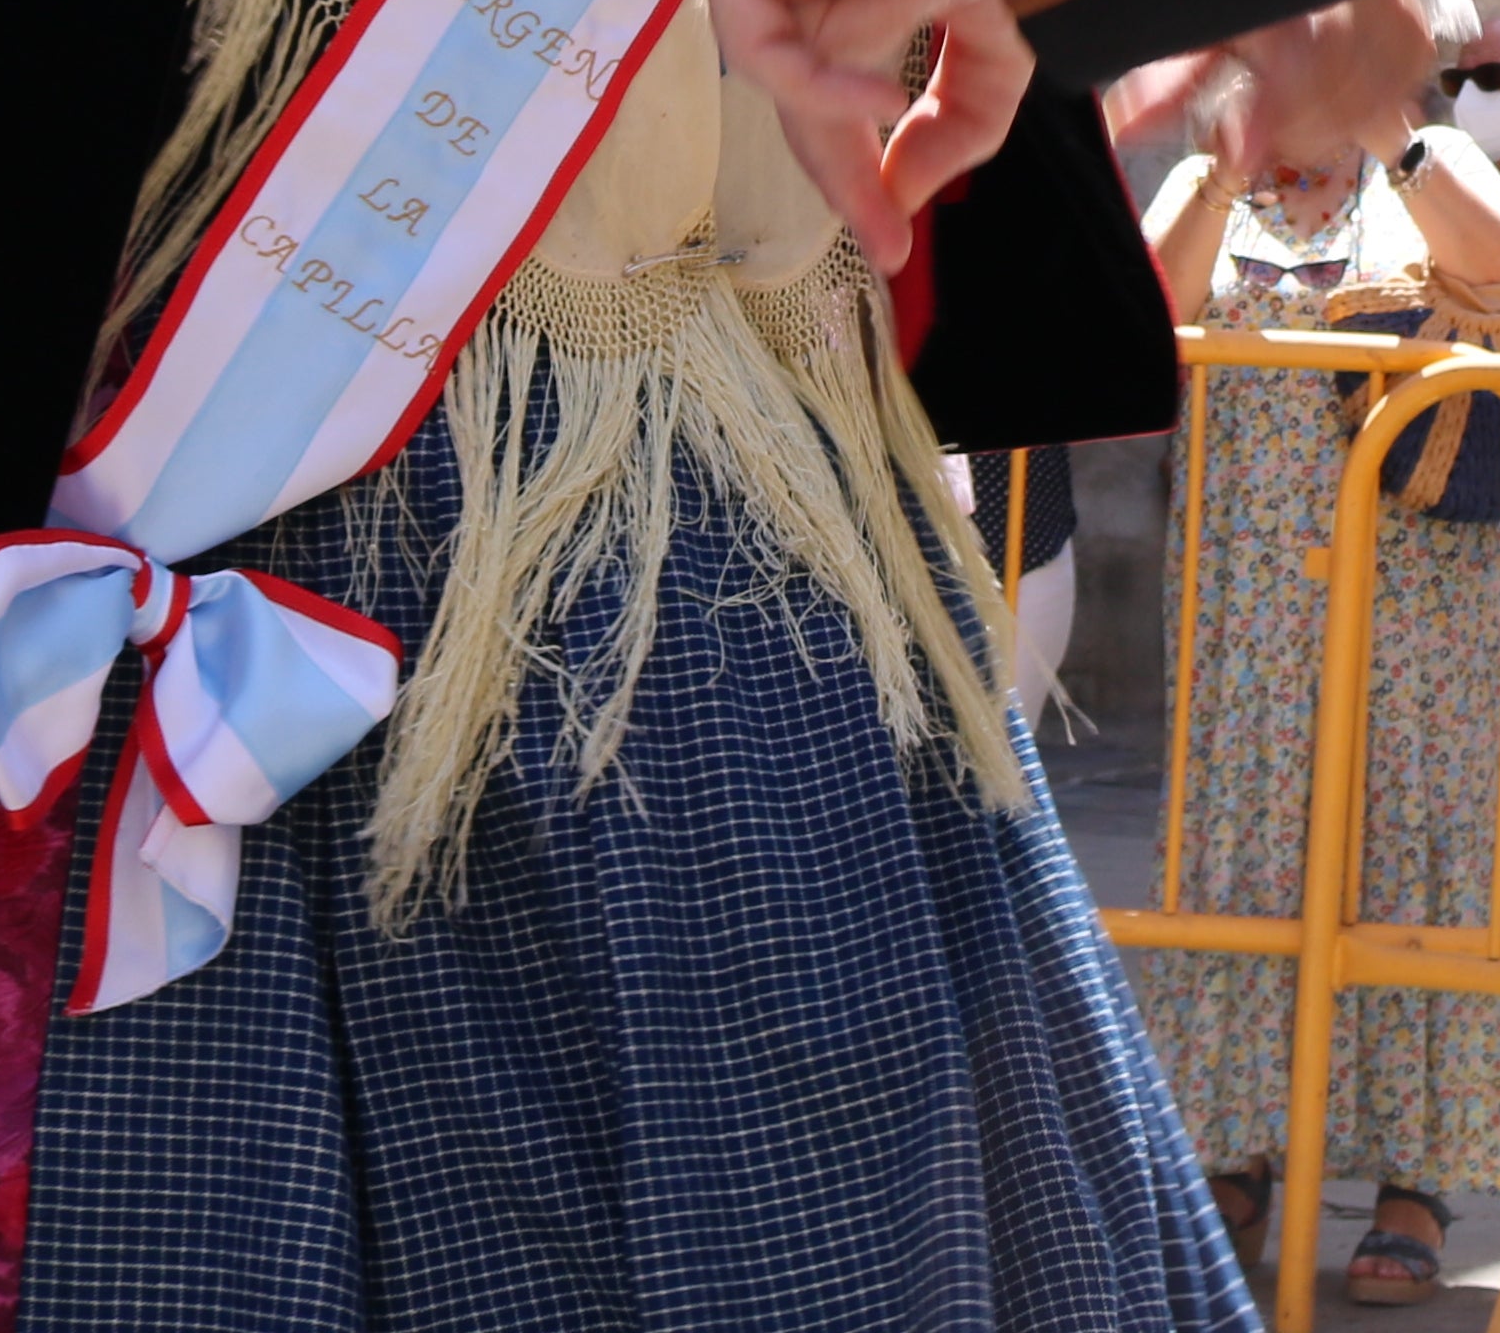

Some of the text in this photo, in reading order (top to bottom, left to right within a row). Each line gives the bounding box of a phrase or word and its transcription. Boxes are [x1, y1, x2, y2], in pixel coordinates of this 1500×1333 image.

[414, 89, 492, 157] DE
[357, 177, 431, 237] LA
[240, 214, 446, 376] CAPILLA
